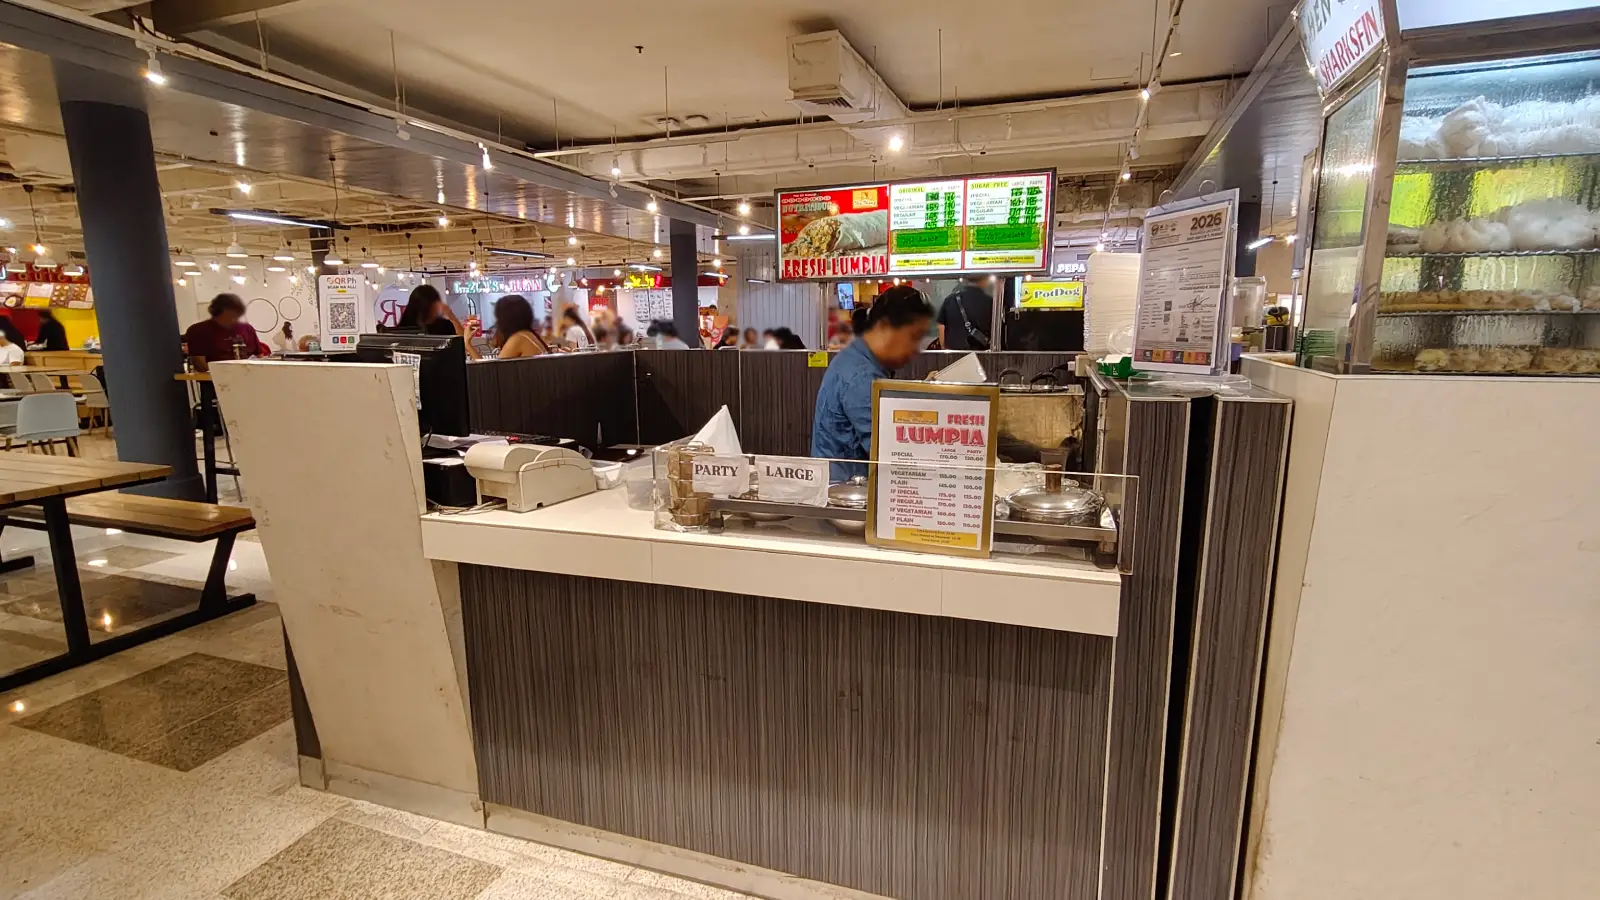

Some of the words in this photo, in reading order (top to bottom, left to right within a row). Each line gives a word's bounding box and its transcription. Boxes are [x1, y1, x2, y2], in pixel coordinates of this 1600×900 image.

[1320, 6, 1380, 87] SHARKSFIN
[1191, 212, 1222, 231] 2026
[783, 258, 827, 278] FRESH
[831, 255, 886, 276] LUMPIA
[947, 414, 985, 426] FRESH
[896, 425, 985, 447] LUMPIA
[694, 464, 738, 477] PARTY
[765, 466, 814, 481] LARGE
[896, 507, 933, 515] VEGETARIAN
